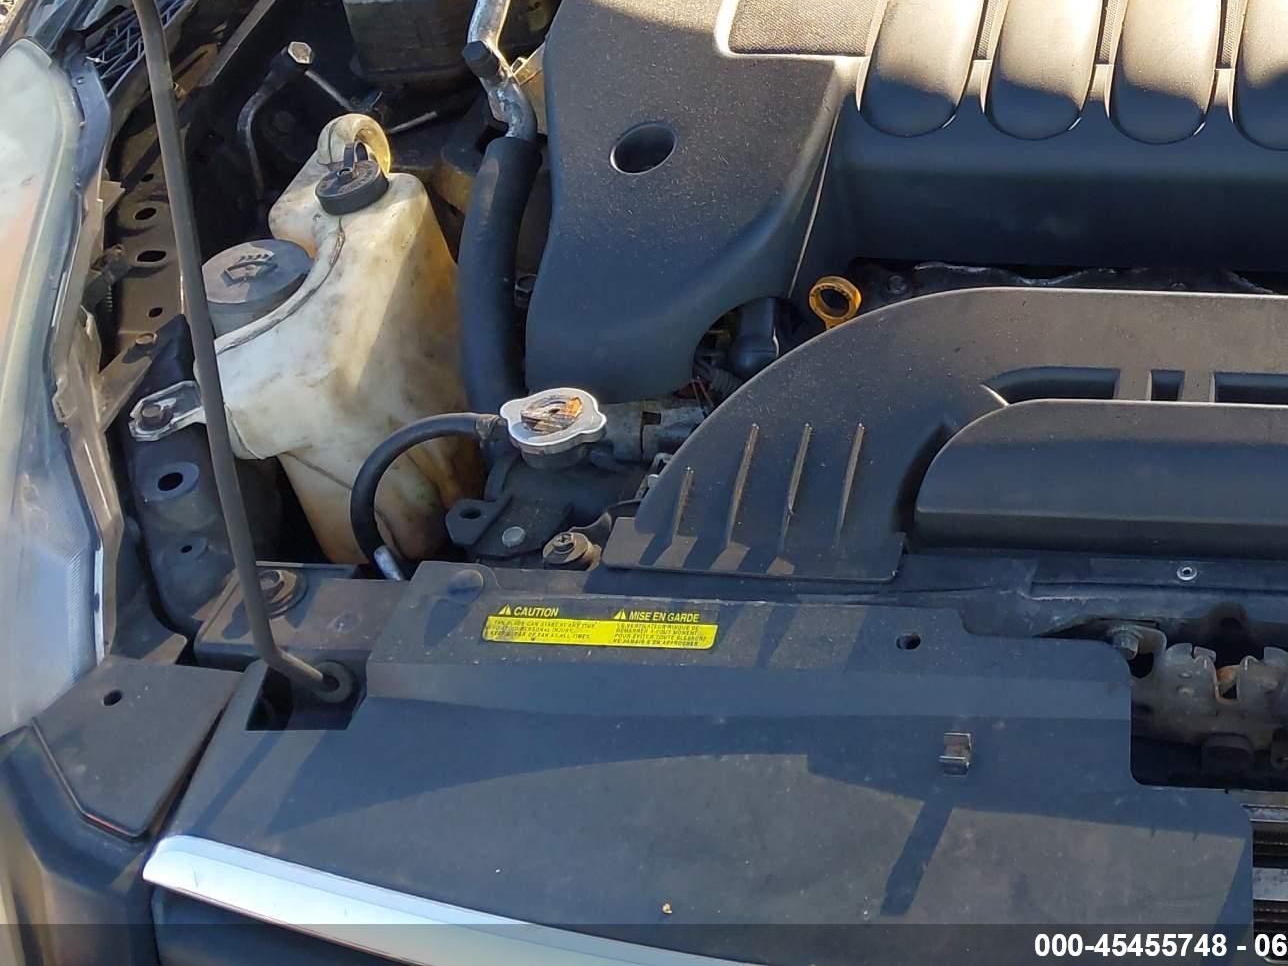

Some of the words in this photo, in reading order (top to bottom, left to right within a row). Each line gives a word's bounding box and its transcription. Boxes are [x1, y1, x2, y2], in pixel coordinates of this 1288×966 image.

[513, 606, 560, 618] CAUTION
[628, 610, 652, 621] MISE
[652, 611, 666, 622] EN
[667, 612, 700, 623] GARDE
